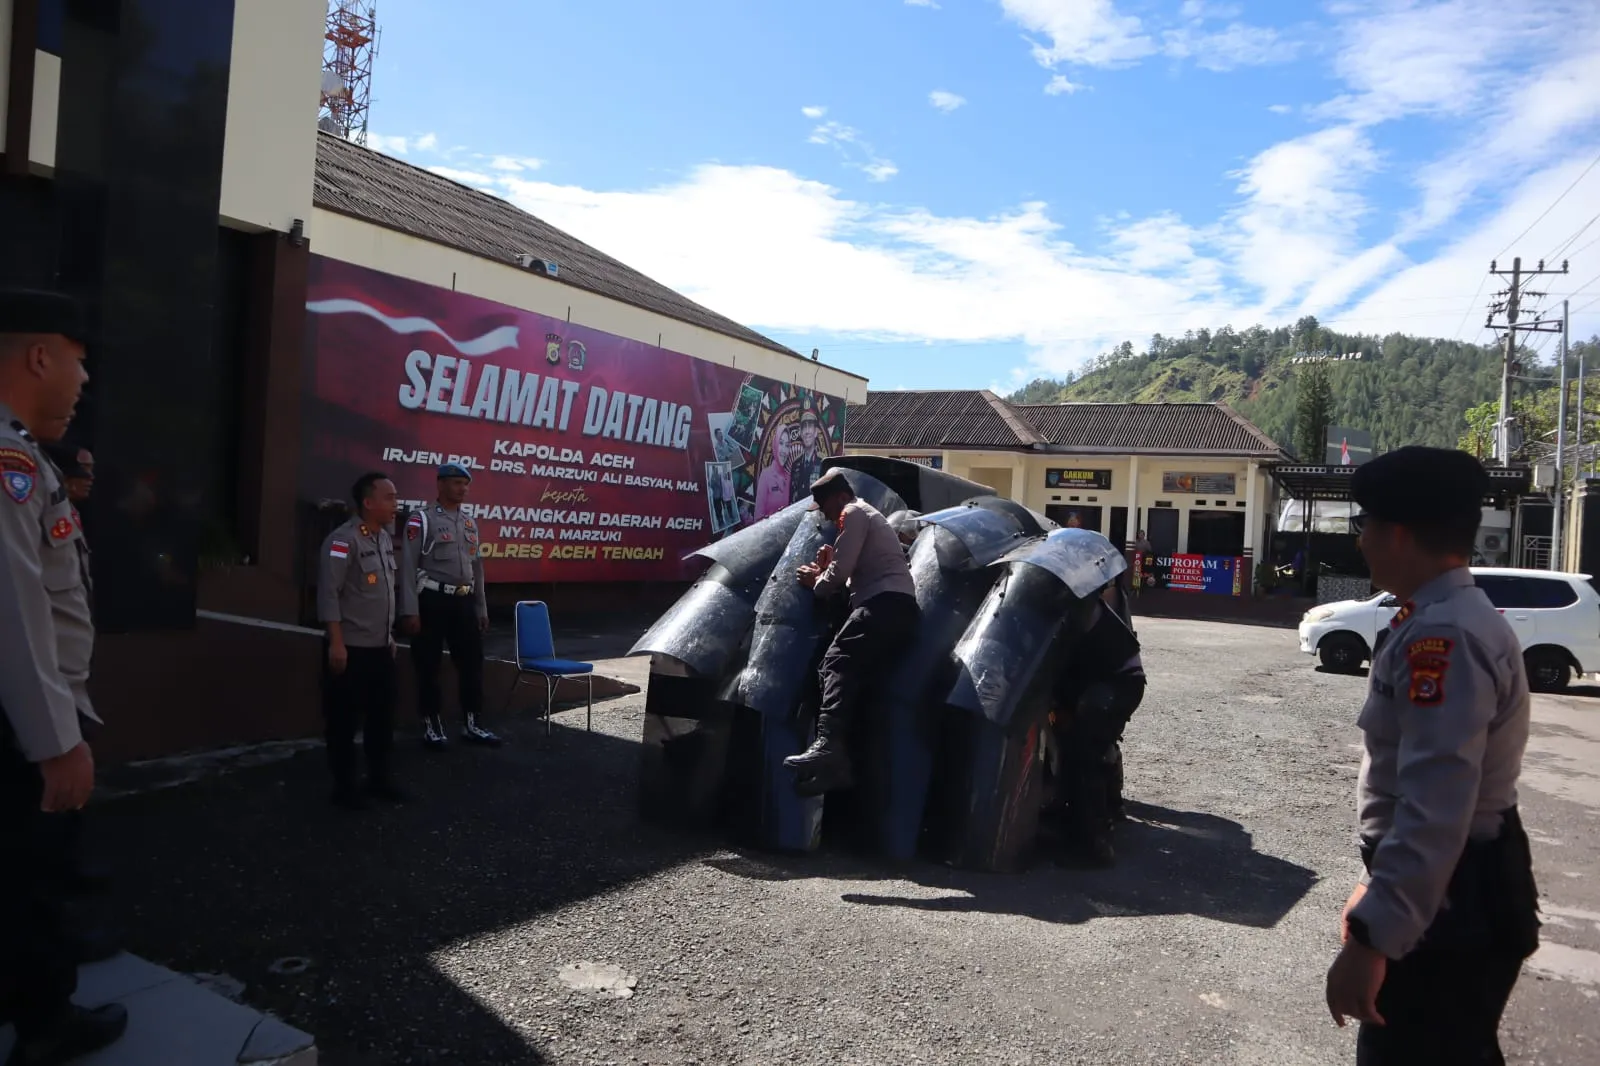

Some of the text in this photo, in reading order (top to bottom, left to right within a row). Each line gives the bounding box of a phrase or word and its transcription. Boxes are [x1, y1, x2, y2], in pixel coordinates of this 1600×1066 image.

[399, 349, 693, 449] SELAMAT DATANG
[493, 440, 635, 470] KAPOLDA ACEH
[383, 448, 443, 465] IRJEN
[490, 459, 526, 474] DRS.
[531, 465, 597, 481] MARZUKI
[601, 472, 621, 484] ALI
[625, 475, 674, 490] BASYAH,
[676, 480, 700, 492] M.M.
[540, 482, 591, 503] beserta
[460, 503, 703, 531] BHAYANGKARI DAERAH ACEH
[499, 526, 622, 542] NY. IRA MARZUKI
[478, 543, 664, 560] OLRES ACEH TENGAH
[1156, 557, 1218, 569] SIPROPAM
[1173, 567, 1201, 575] POLRES
[1184, 575, 1212, 583] TENGAH
